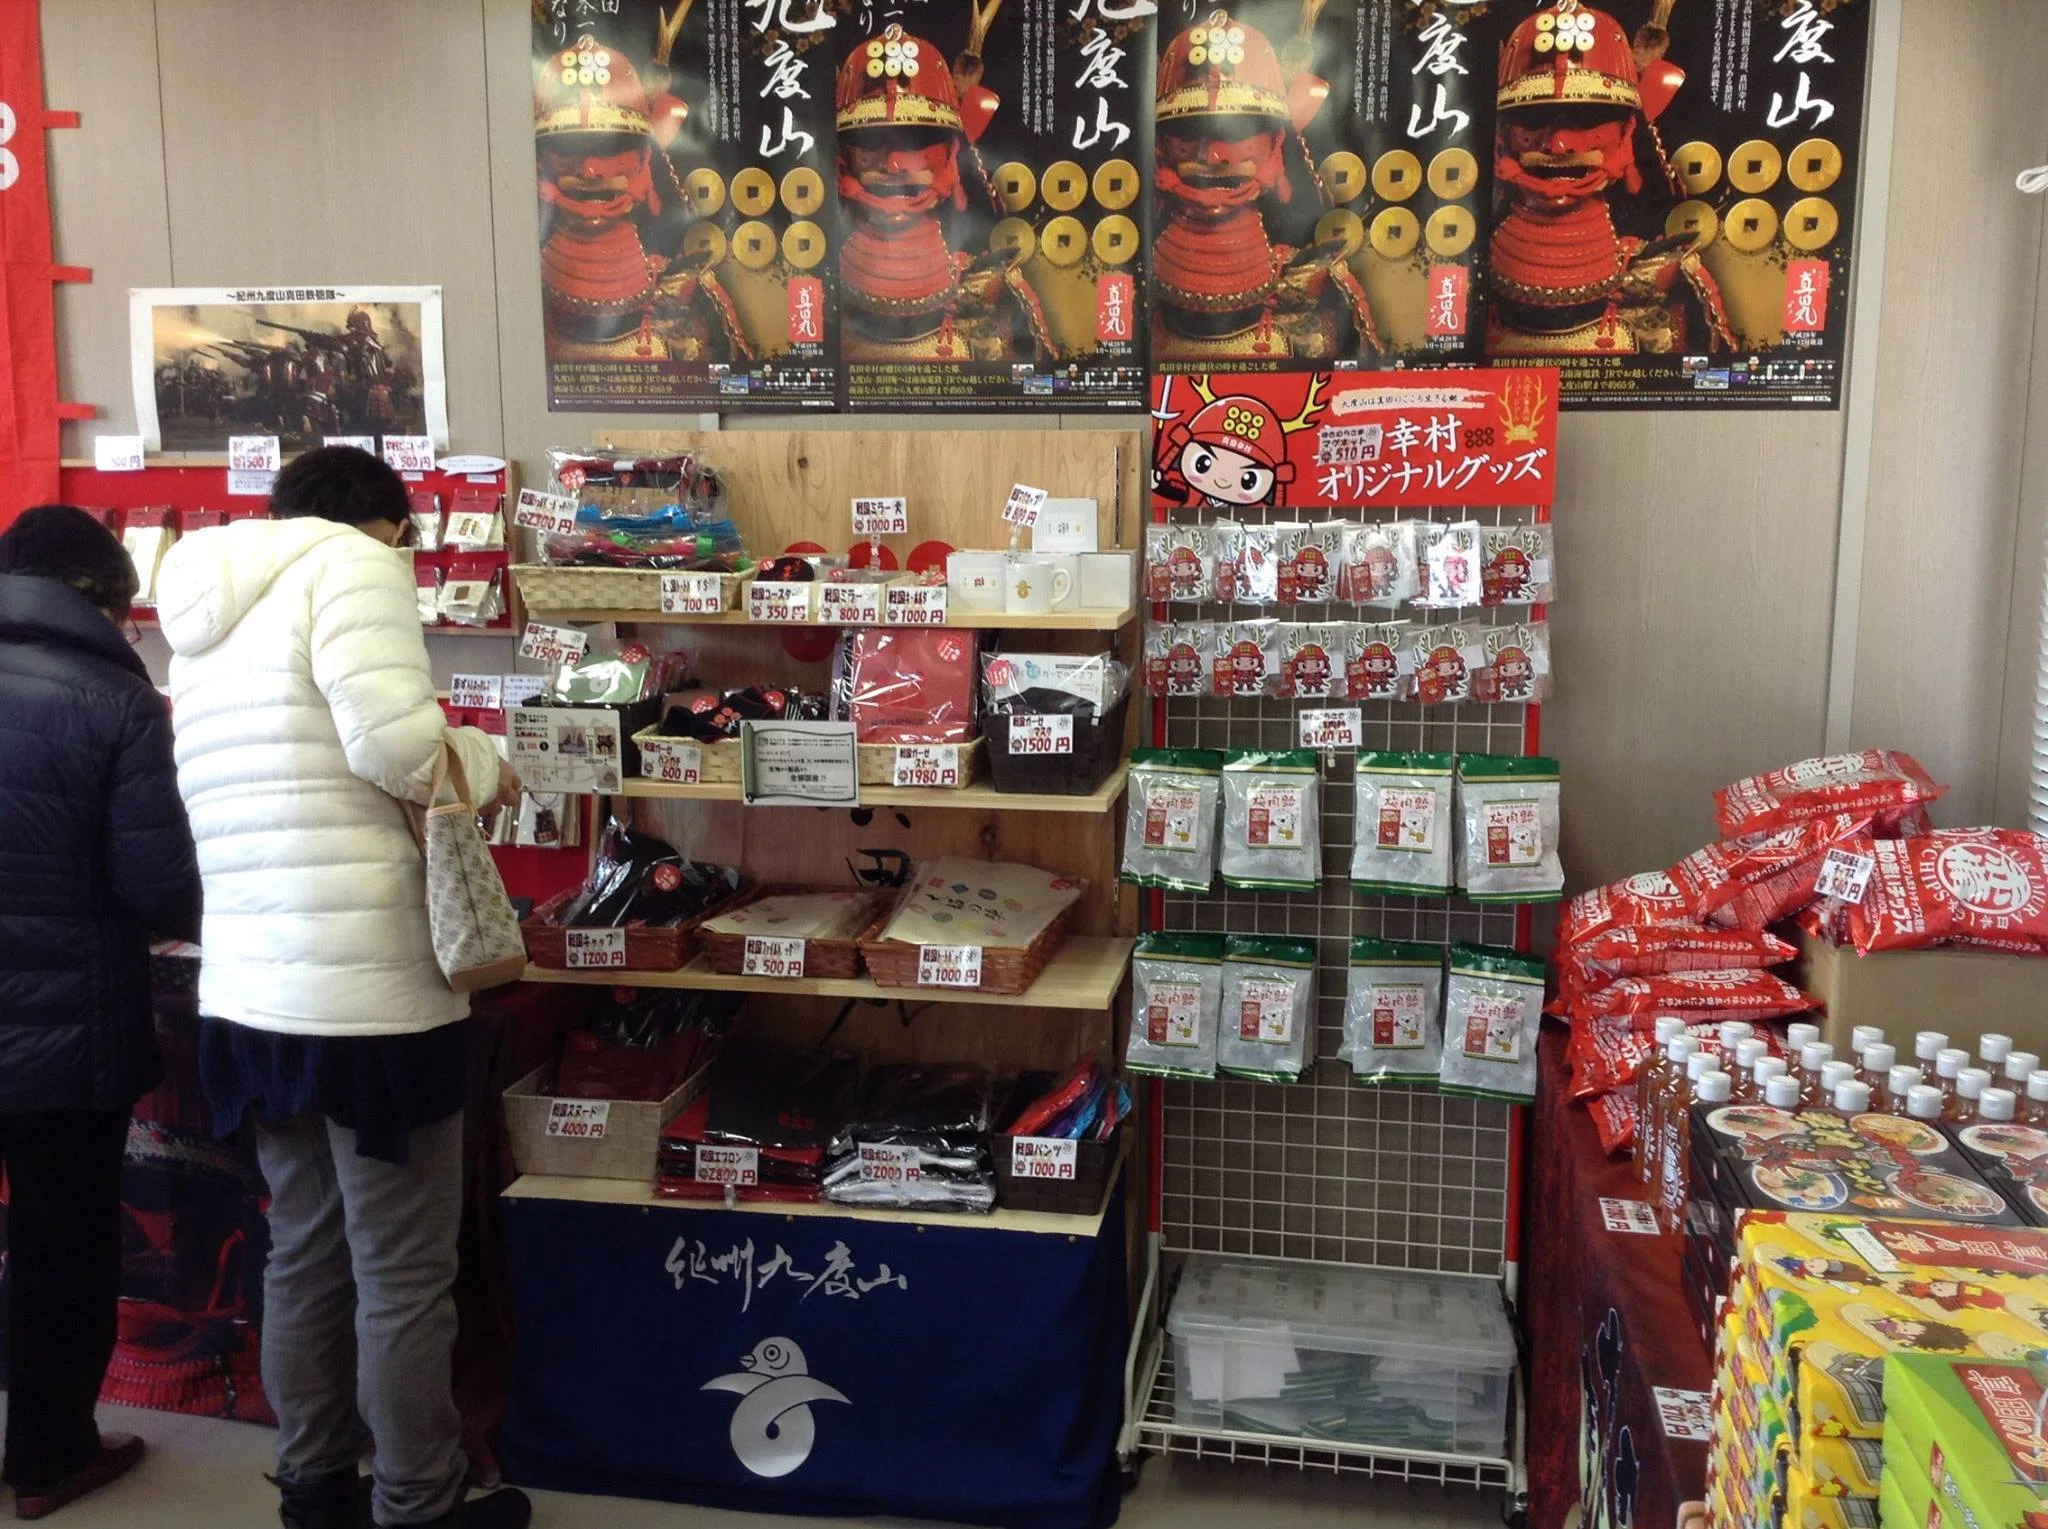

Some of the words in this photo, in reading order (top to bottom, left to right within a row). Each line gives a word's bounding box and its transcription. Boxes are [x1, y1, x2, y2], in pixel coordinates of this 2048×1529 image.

[1385, 413, 1463, 458] 幸村
[1317, 449, 1547, 501] オリジナルグッズ
[665, 1236, 908, 1313] 紀州九度山
